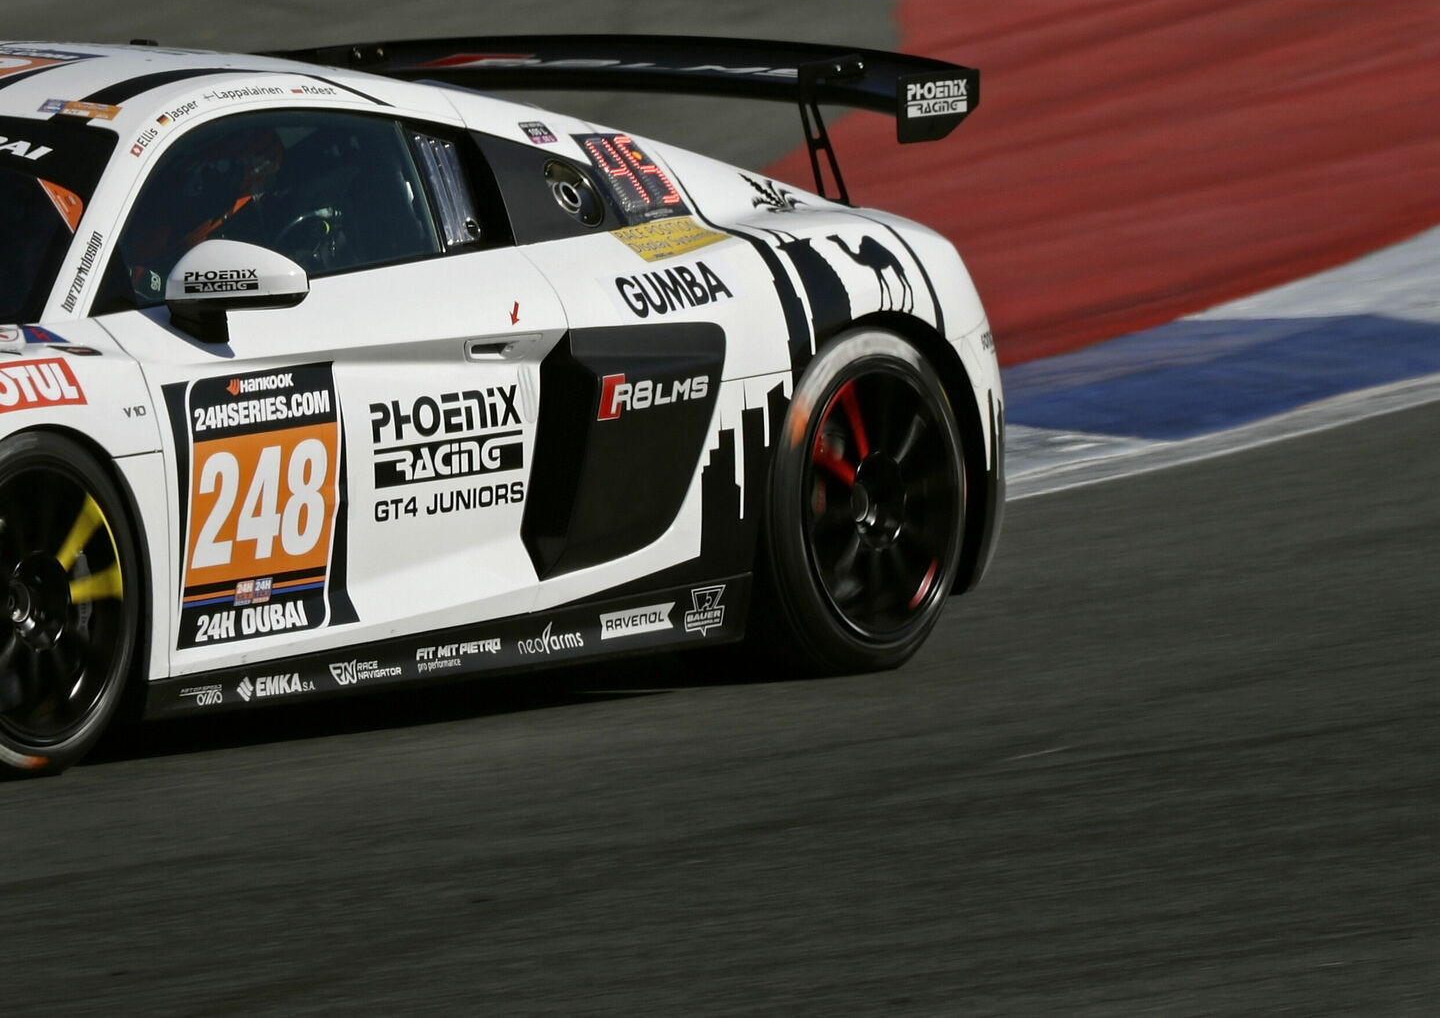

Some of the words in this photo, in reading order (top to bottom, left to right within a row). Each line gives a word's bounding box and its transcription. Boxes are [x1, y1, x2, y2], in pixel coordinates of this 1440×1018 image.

[213, 86, 285, 101] Lappalainen
[302, 85, 338, 96] Rdest
[166, 99, 199, 122] Jasper
[137, 127, 159, 148] Ellis
[613, 228, 649, 240] RACE
[614, 261, 734, 319] GUMBA
[194, 389, 331, 432] 24HSERIES.COM
[369, 384, 524, 444] PHOENIX
[190, 437, 329, 570] 248
[374, 496, 419, 522] GT4
[425, 482, 525, 518] JUNIORS
[196, 610, 236, 642] 24H
[241, 600, 309, 635] DUBAI
[605, 610, 666, 633] RAVENOL
[686, 609, 721, 623] BAUER
[415, 646, 436, 661] FIT
[436, 643, 460, 659] MIT
[459, 637, 502, 656] PIETRO
[357, 660, 379, 672] RACE
[357, 666, 403, 681] NAVIGATOR
[427, 657, 462, 672] performance
[255, 672, 303, 697] EMKA
